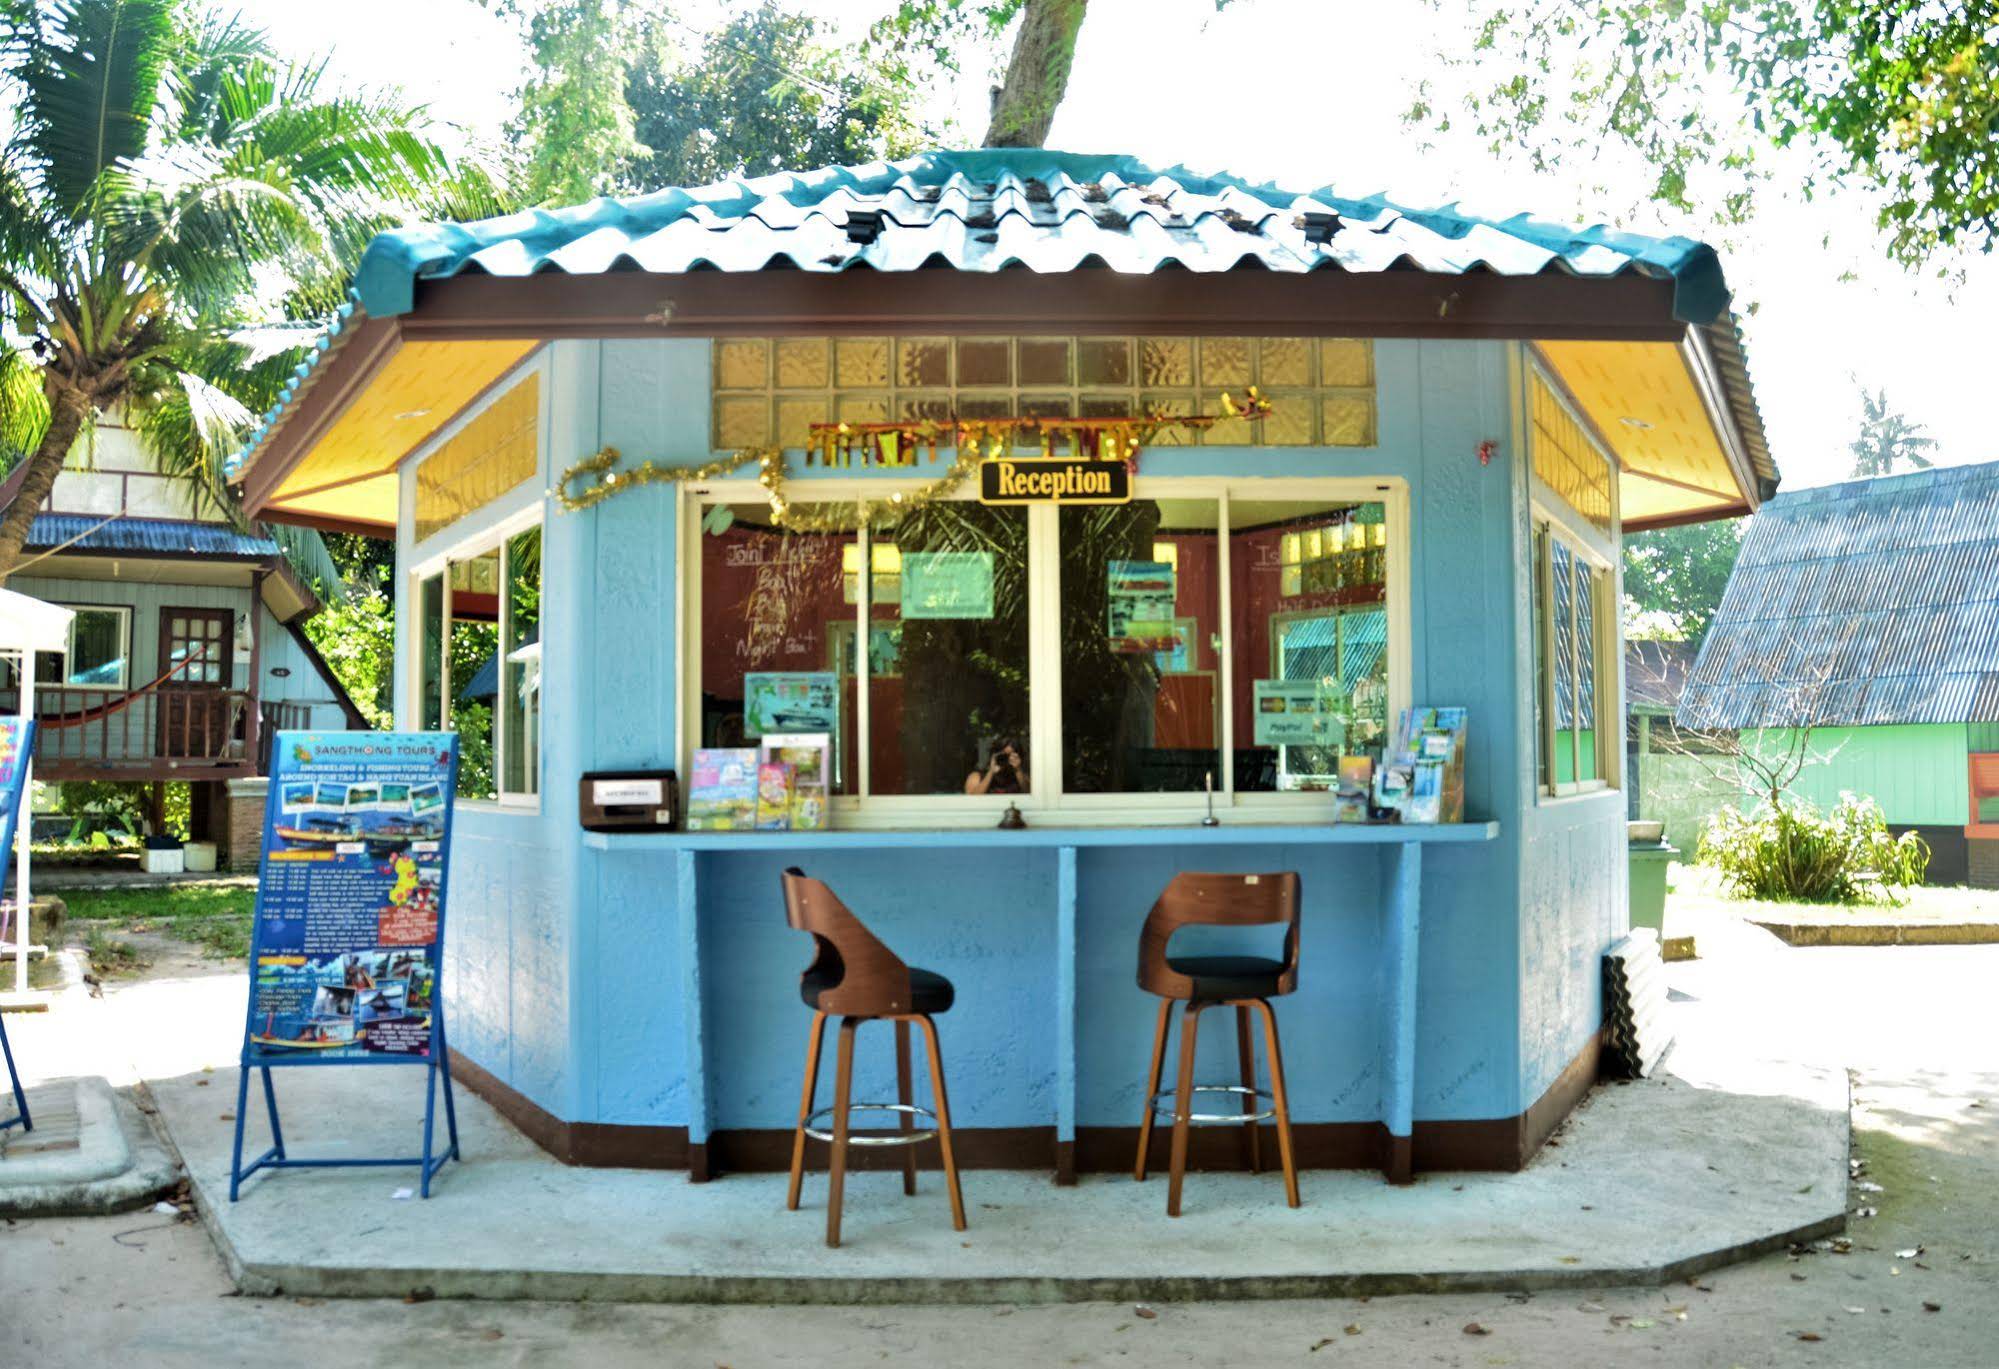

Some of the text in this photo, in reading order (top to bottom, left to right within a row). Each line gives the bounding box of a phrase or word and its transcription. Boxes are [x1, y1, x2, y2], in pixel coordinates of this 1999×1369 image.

[998, 462, 1111, 500] Reception
[315, 745, 436, 756] SANGTHONG TOURS
